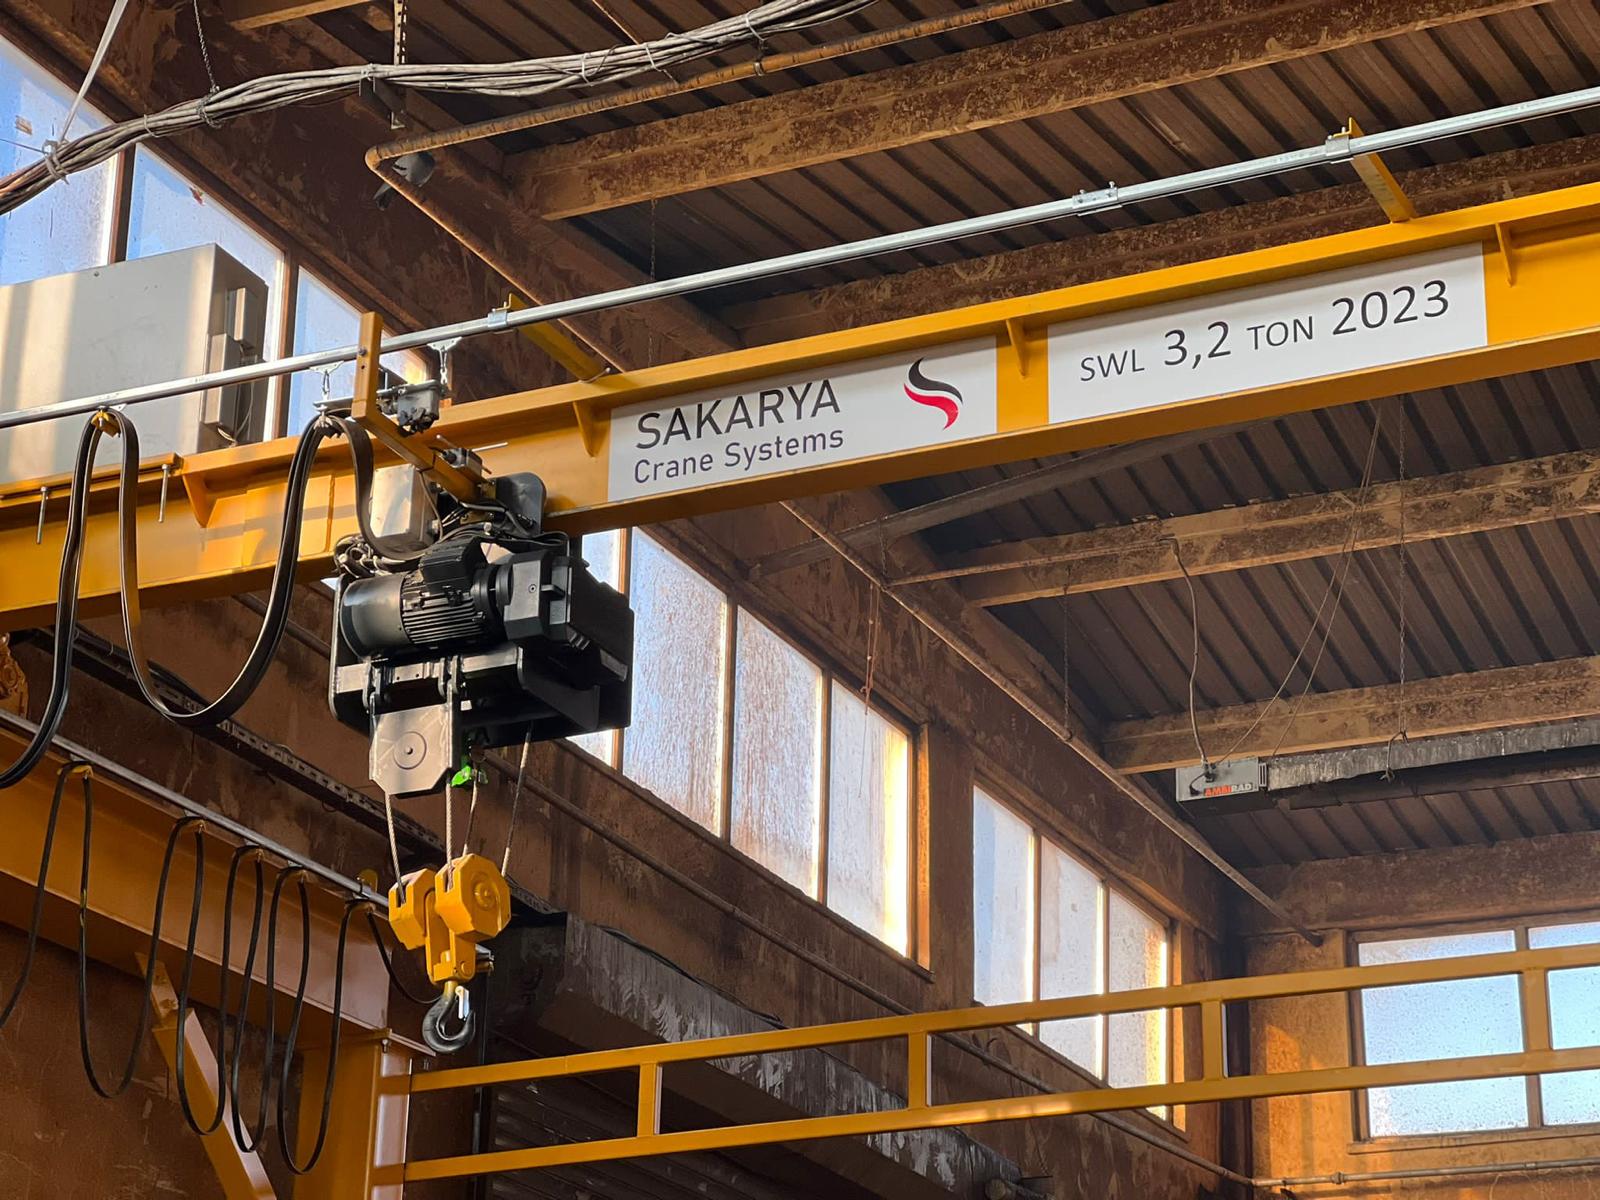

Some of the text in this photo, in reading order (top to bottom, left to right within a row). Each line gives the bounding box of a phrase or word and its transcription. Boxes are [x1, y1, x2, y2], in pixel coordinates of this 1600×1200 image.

[1080, 279, 1450, 382] SWL 3,2 TON 2023
[635, 379, 840, 449] SAKARYA
[634, 429, 844, 483] Crane Systems
[1205, 783, 1252, 796] AMBIRAD
